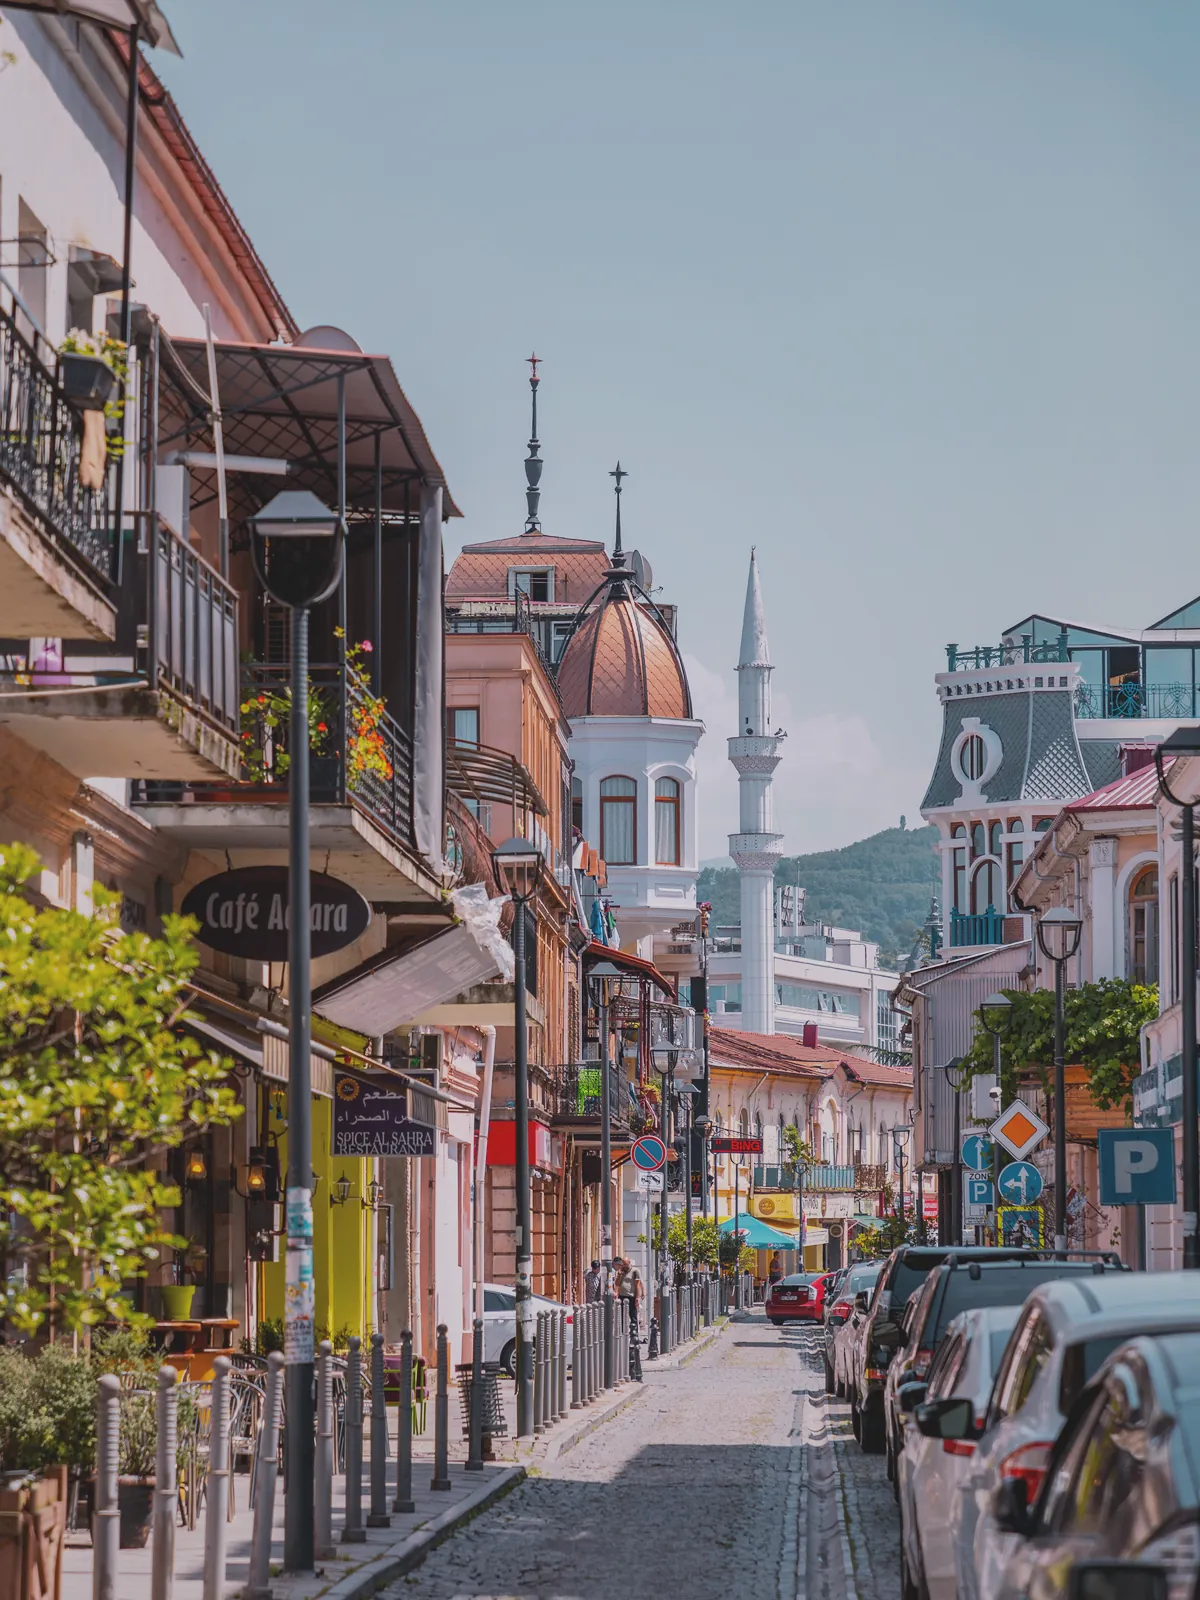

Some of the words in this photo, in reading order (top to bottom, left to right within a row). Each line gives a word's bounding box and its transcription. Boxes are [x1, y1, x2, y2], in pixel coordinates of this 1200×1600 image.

[206, 892, 260, 934] Café
[337, 1132, 370, 1146] SPICE
[373, 1132, 389, 1146] AL
[391, 1132, 433, 1146] SAHRA
[340, 1143, 427, 1155] RESTAURANT
[1113, 1140, 1159, 1194] P
[974, 1182, 988, 1202] P
